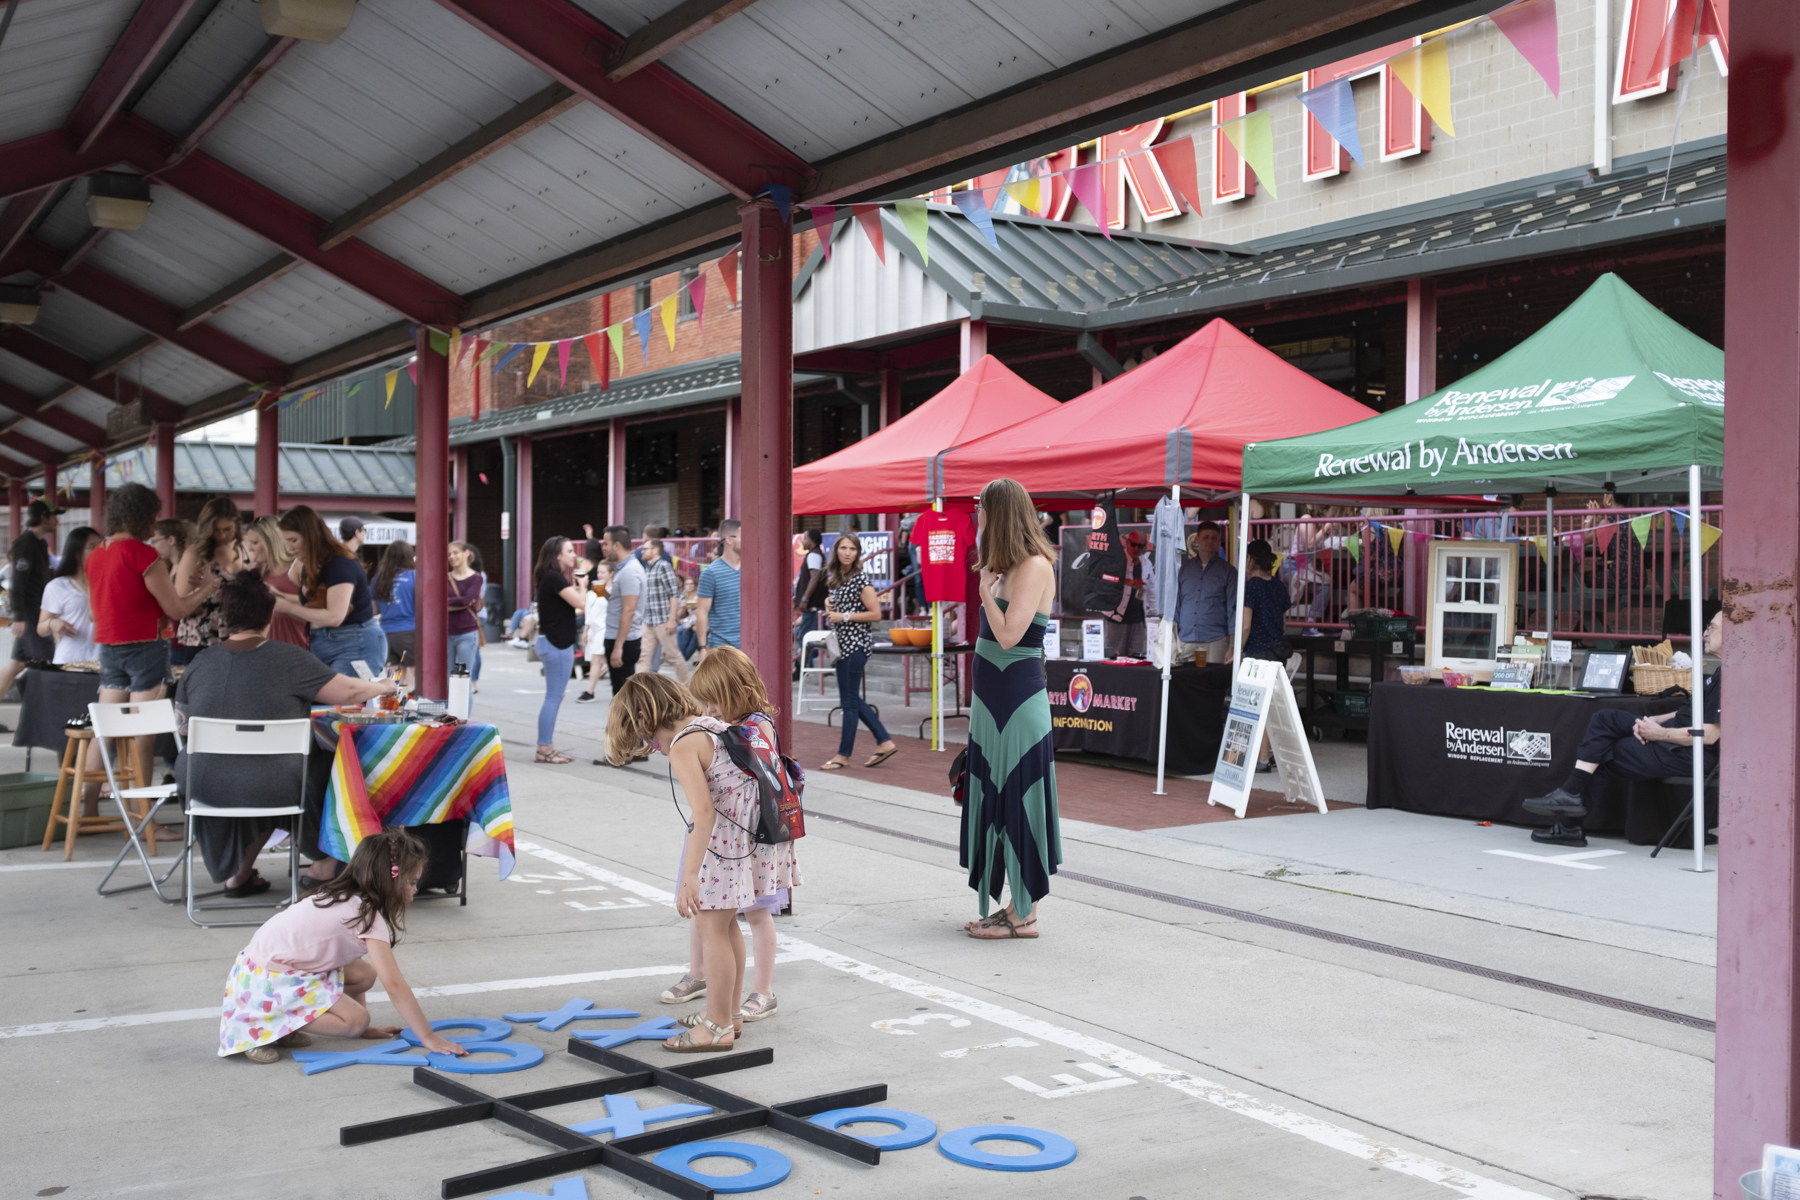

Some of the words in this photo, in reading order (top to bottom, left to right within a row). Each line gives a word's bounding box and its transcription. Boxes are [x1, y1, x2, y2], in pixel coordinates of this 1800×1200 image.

[1434, 378, 1552, 407] Renewal
[1457, 410, 1522, 421] REPLACEMENT
[1314, 442, 1411, 478] Renewal
[1419, 440, 1449, 476] by
[376, 527, 409, 541] STATION
[859, 536, 889, 554] IGHT
[1092, 693, 1138, 711] MARKET
[1445, 721, 1504, 743] Renewal
[1470, 753, 1503, 764] REPLACEMENT
